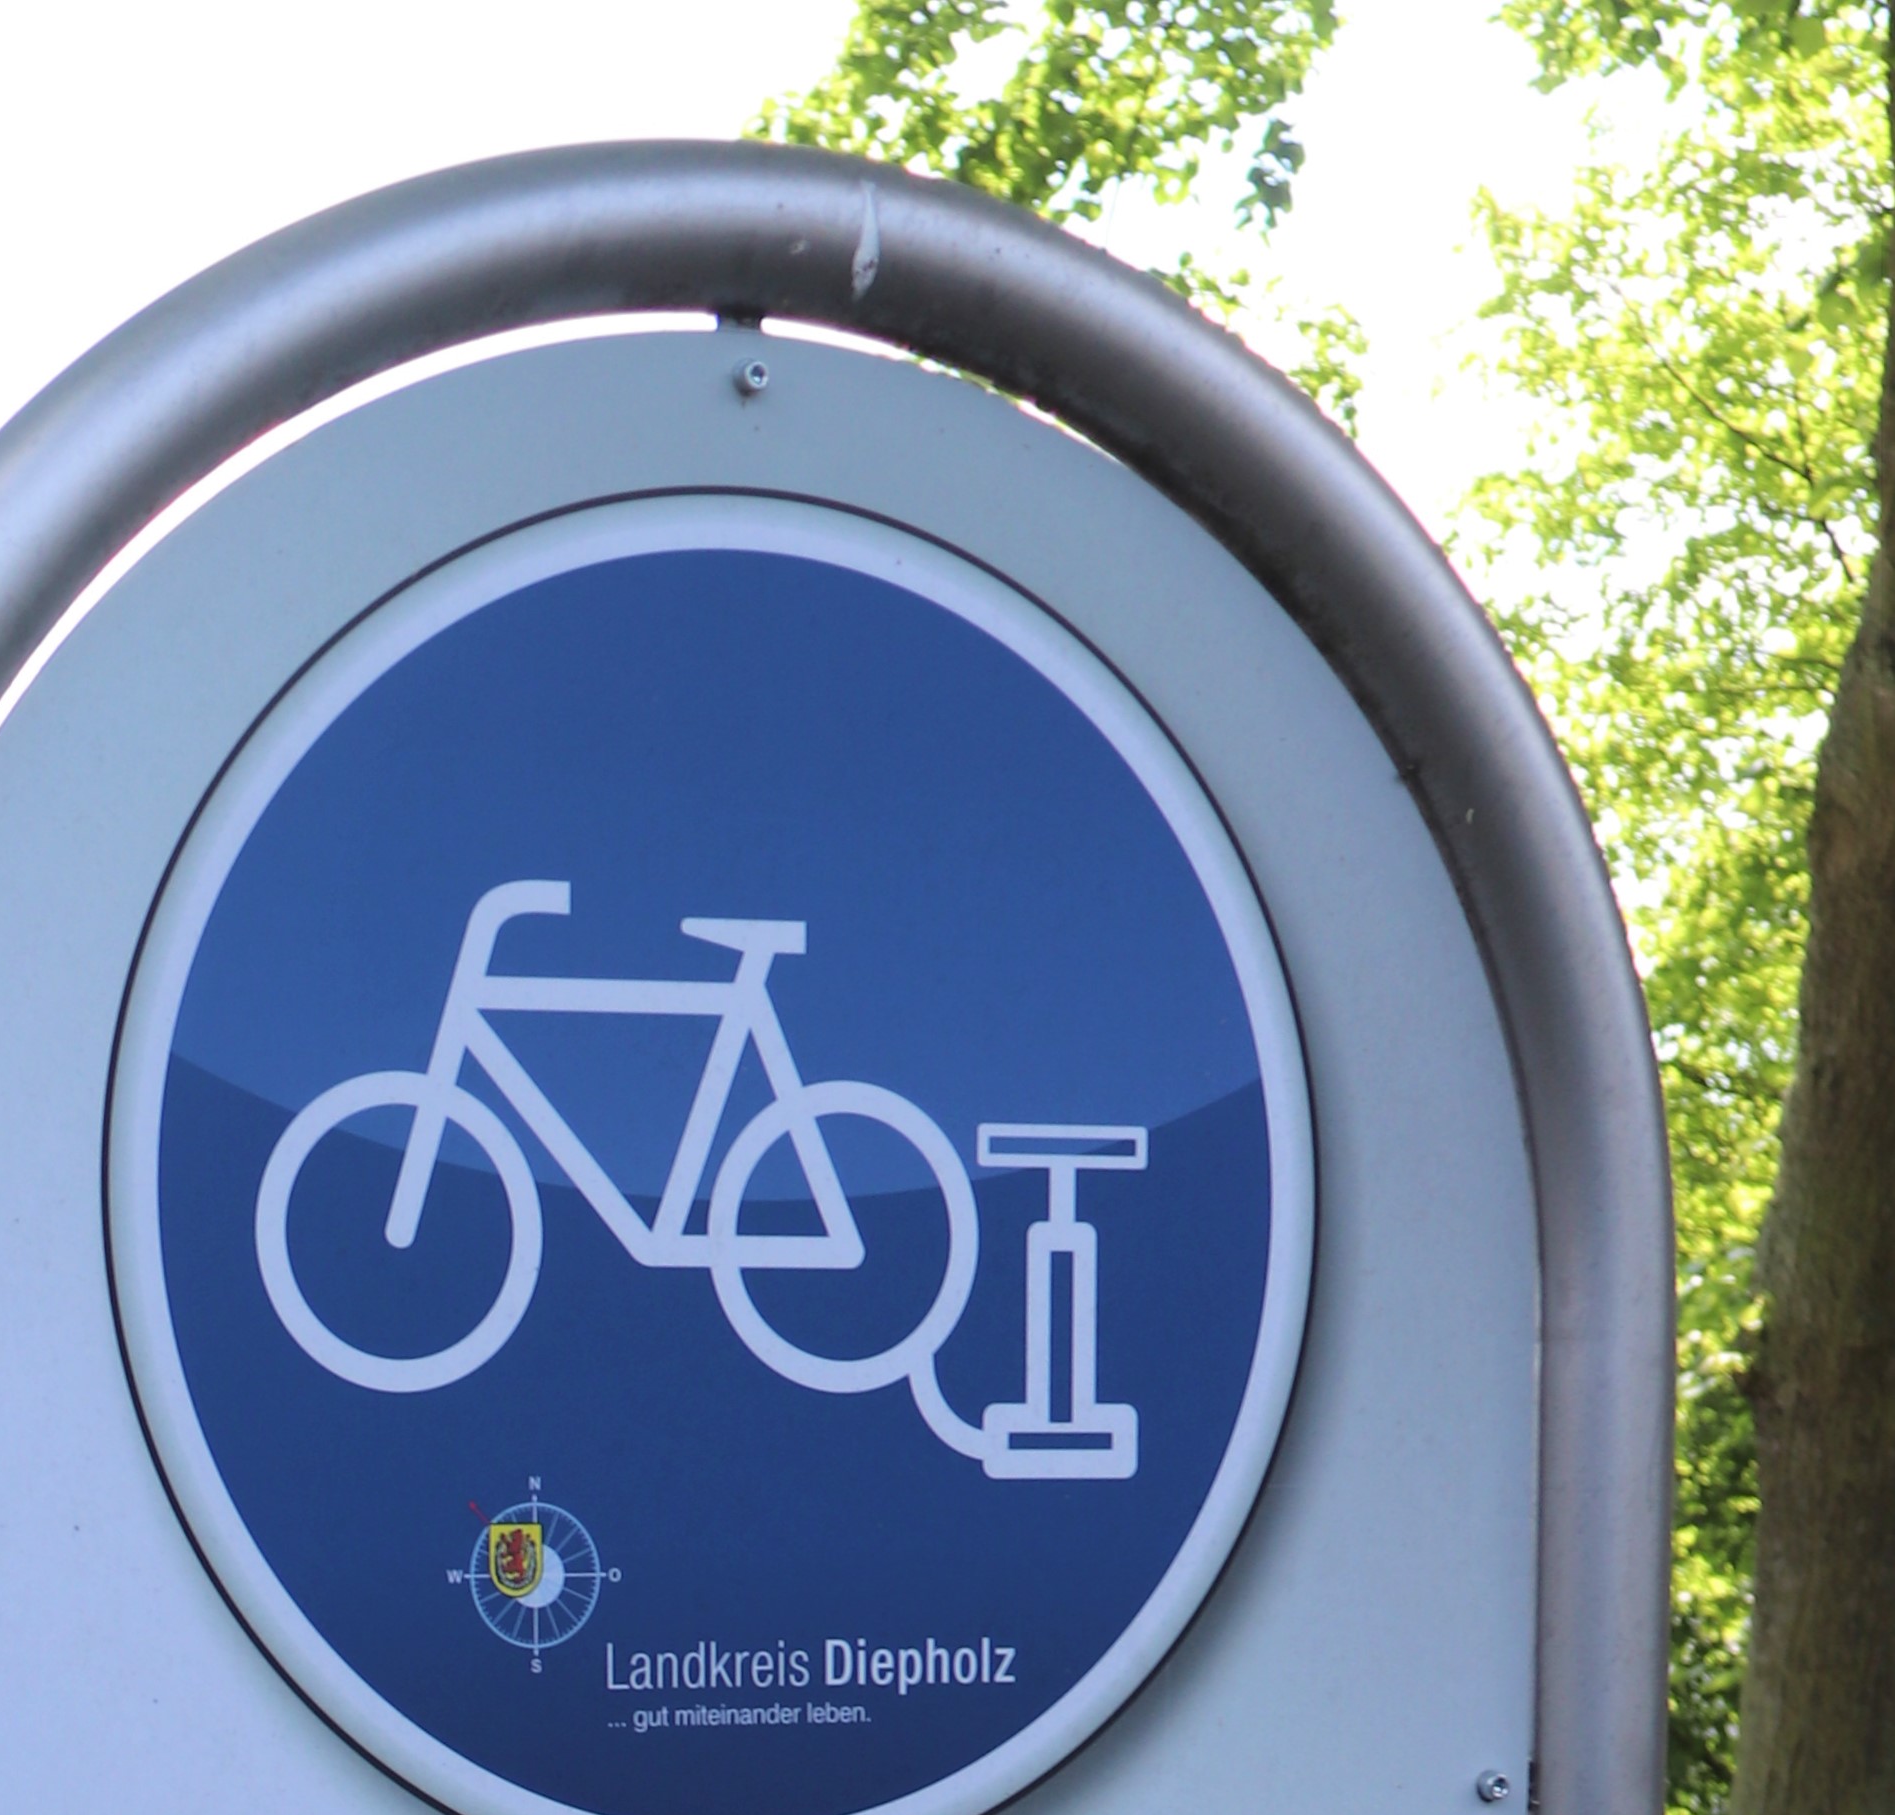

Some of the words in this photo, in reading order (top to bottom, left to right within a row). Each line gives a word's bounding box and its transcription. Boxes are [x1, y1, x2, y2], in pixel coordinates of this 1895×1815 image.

[528, 1476, 542, 1491] N
[446, 1569, 463, 1585] W
[608, 1567, 622, 1583] O
[530, 1659, 543, 1674] S
[606, 1642, 810, 1690] Landkreis
[824, 1637, 1017, 1695] Diepholz
[633, 1706, 669, 1732] gut
[674, 1703, 802, 1727] miteinander
[807, 1702, 872, 1724] leben.
